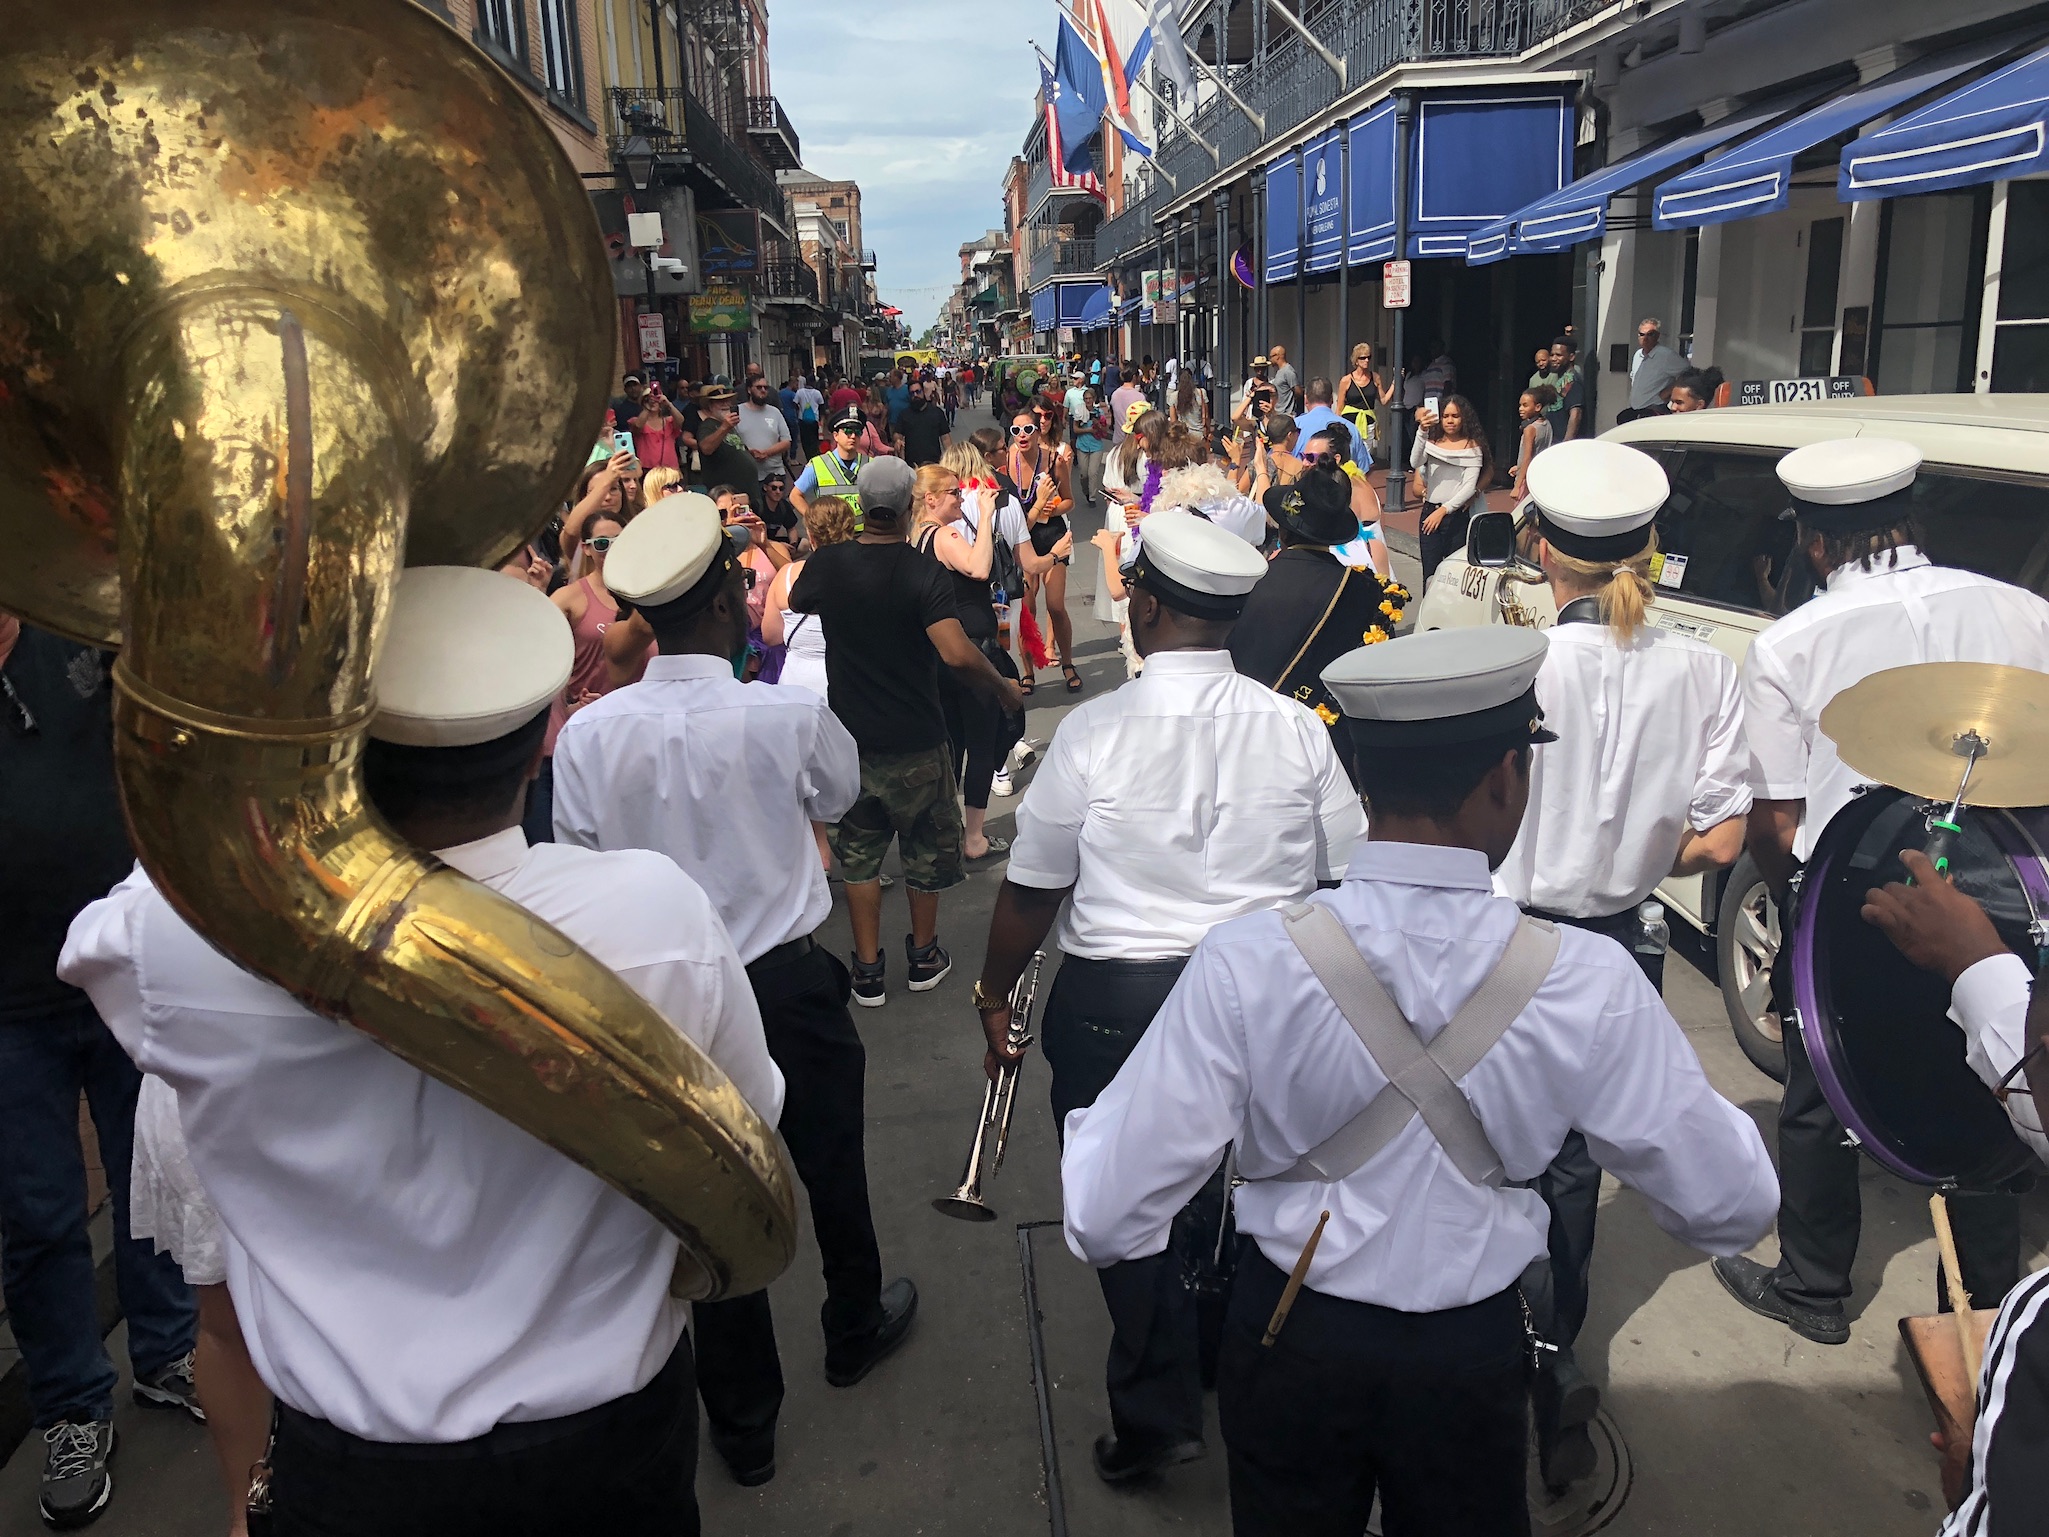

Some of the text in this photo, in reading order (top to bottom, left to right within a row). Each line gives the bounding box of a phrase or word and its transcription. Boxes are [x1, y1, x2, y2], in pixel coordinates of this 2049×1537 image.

[1319, 197, 1339, 215] SONESTA
[719, 296, 746, 306] DEAUX
[645, 330, 658, 338] FIRE
[646, 340, 660, 349] LANE
[1743, 384, 1761, 394] OFF
[1832, 381, 1850, 391] OFF
[1774, 381, 1821, 403] 0231
[1741, 395, 1765, 405] DUTY
[1461, 565, 1490, 602] 0231
